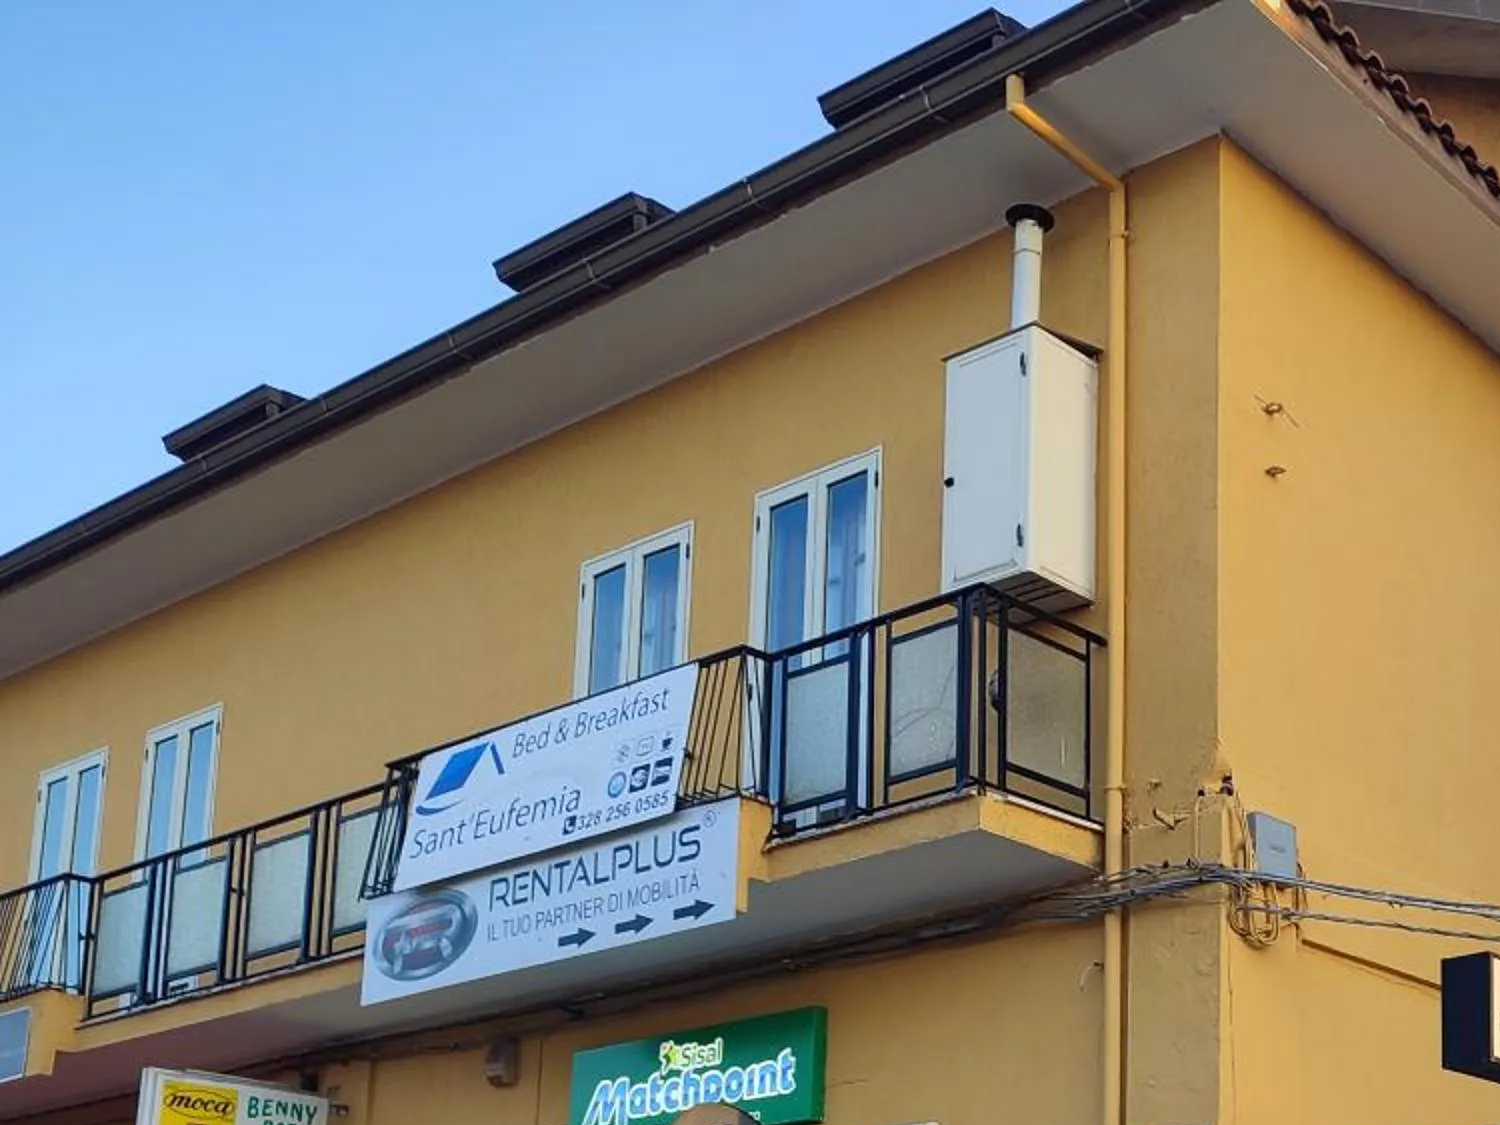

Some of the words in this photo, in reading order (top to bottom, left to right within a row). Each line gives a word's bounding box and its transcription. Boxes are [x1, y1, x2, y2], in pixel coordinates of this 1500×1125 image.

[511, 724, 550, 759] Bed
[554, 719, 570, 745] &
[574, 687, 671, 739] Breakfast
[409, 785, 582, 859] Sant'Eufemia
[605, 801, 631, 822] 256
[635, 789, 669, 814] 0585
[488, 824, 702, 912] RENTALPLUS
[486, 922, 499, 943] IL
[503, 912, 532, 936] TUO
[535, 897, 605, 931] PARTNER
[607, 892, 624, 914] DI
[680, 1037, 724, 1069] Sisal
[247, 1095, 318, 1125] BENNY
